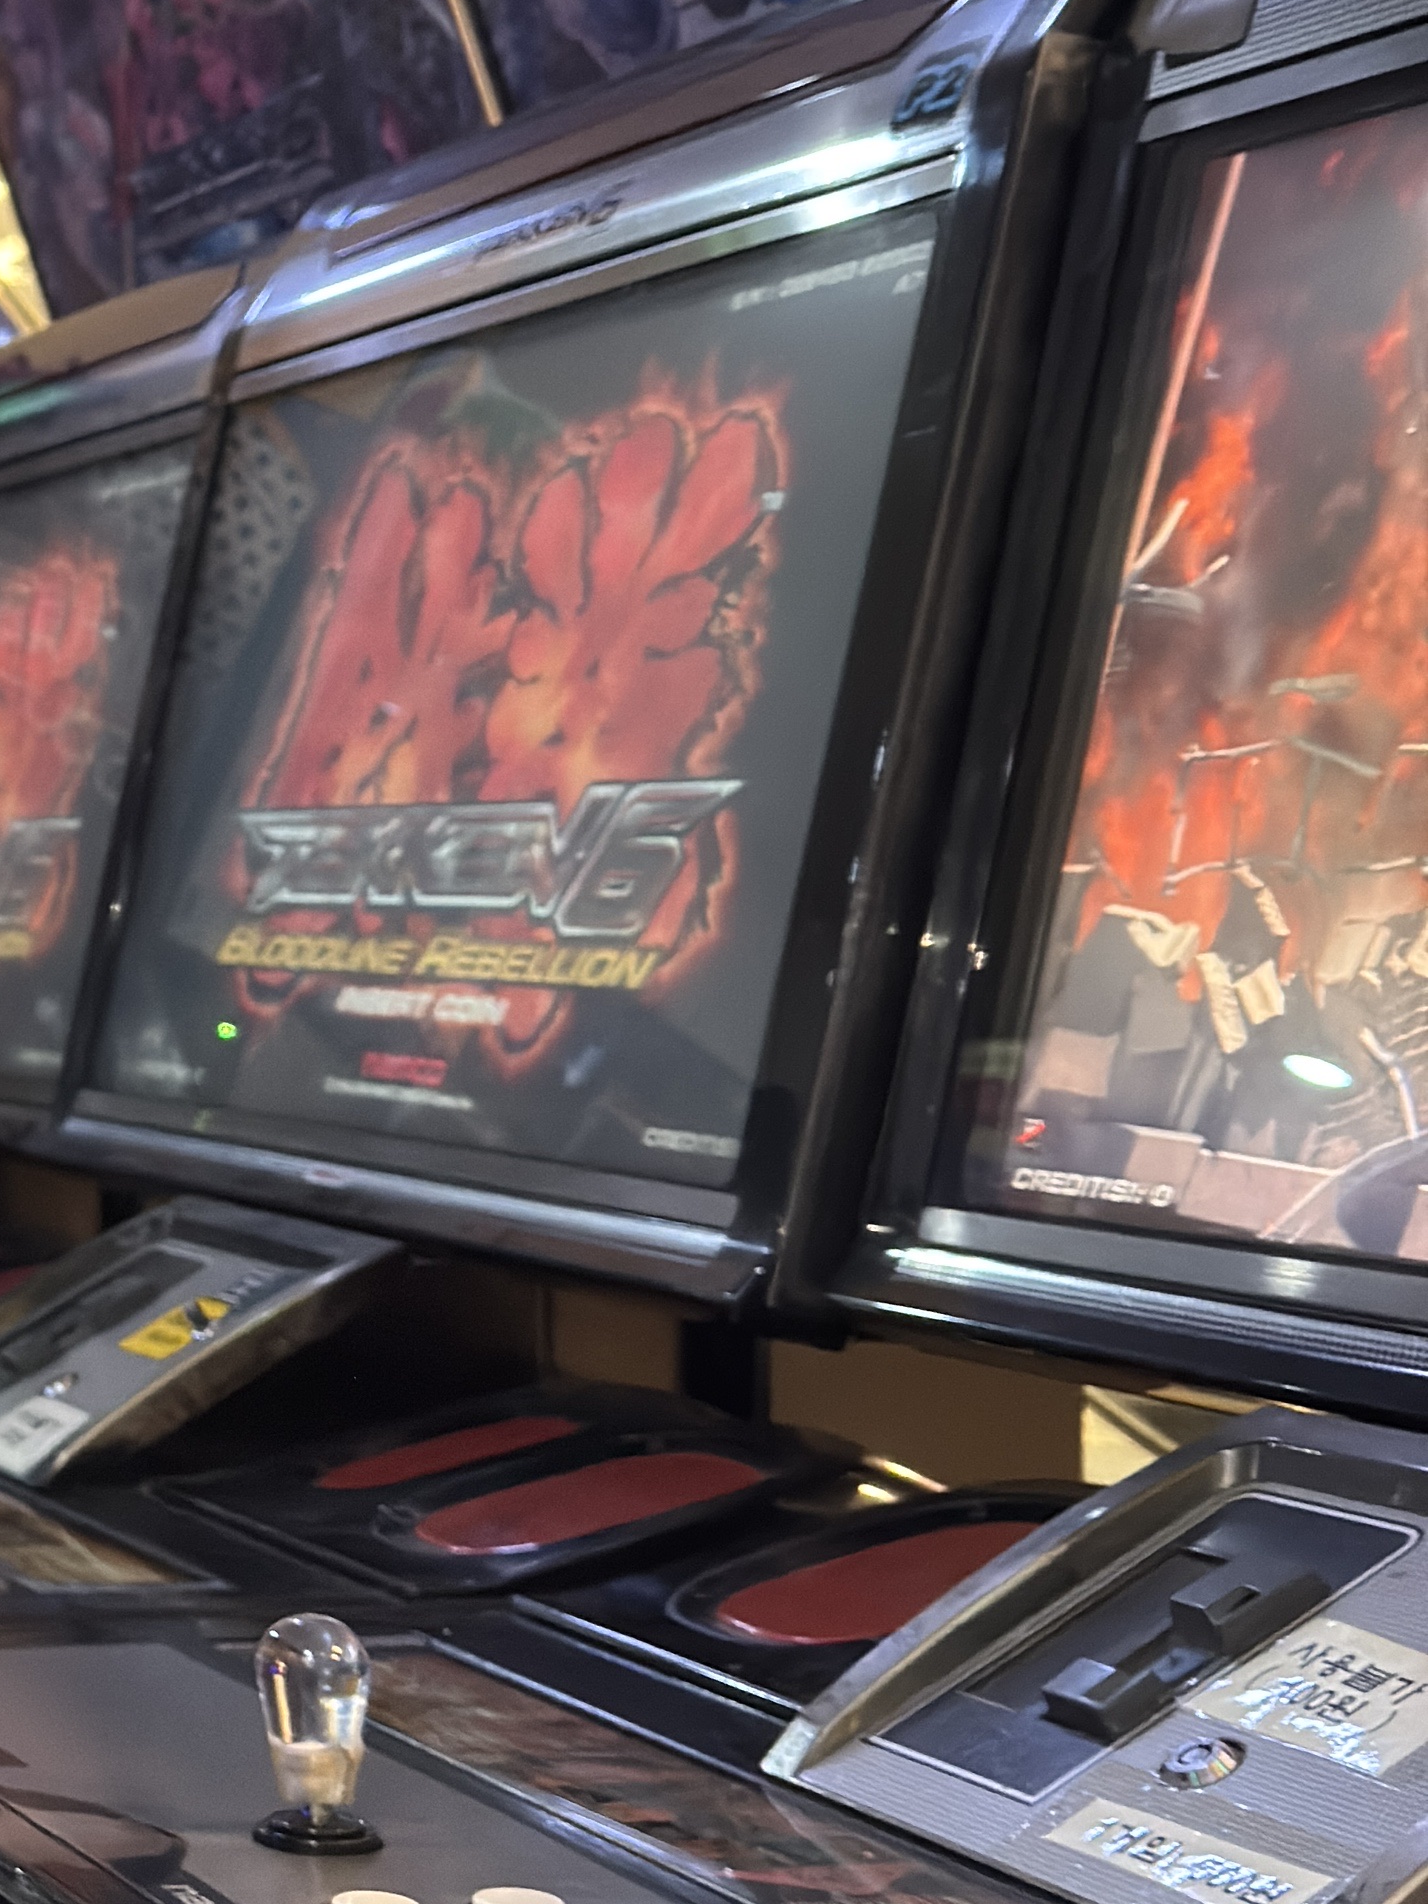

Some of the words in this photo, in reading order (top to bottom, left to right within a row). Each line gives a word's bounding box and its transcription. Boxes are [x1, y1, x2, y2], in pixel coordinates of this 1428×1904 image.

[217, 925, 417, 977] BLOODLINE
[414, 932, 660, 991] REBELLION
[1288, 1641, 1428, 1706] 사용불가
